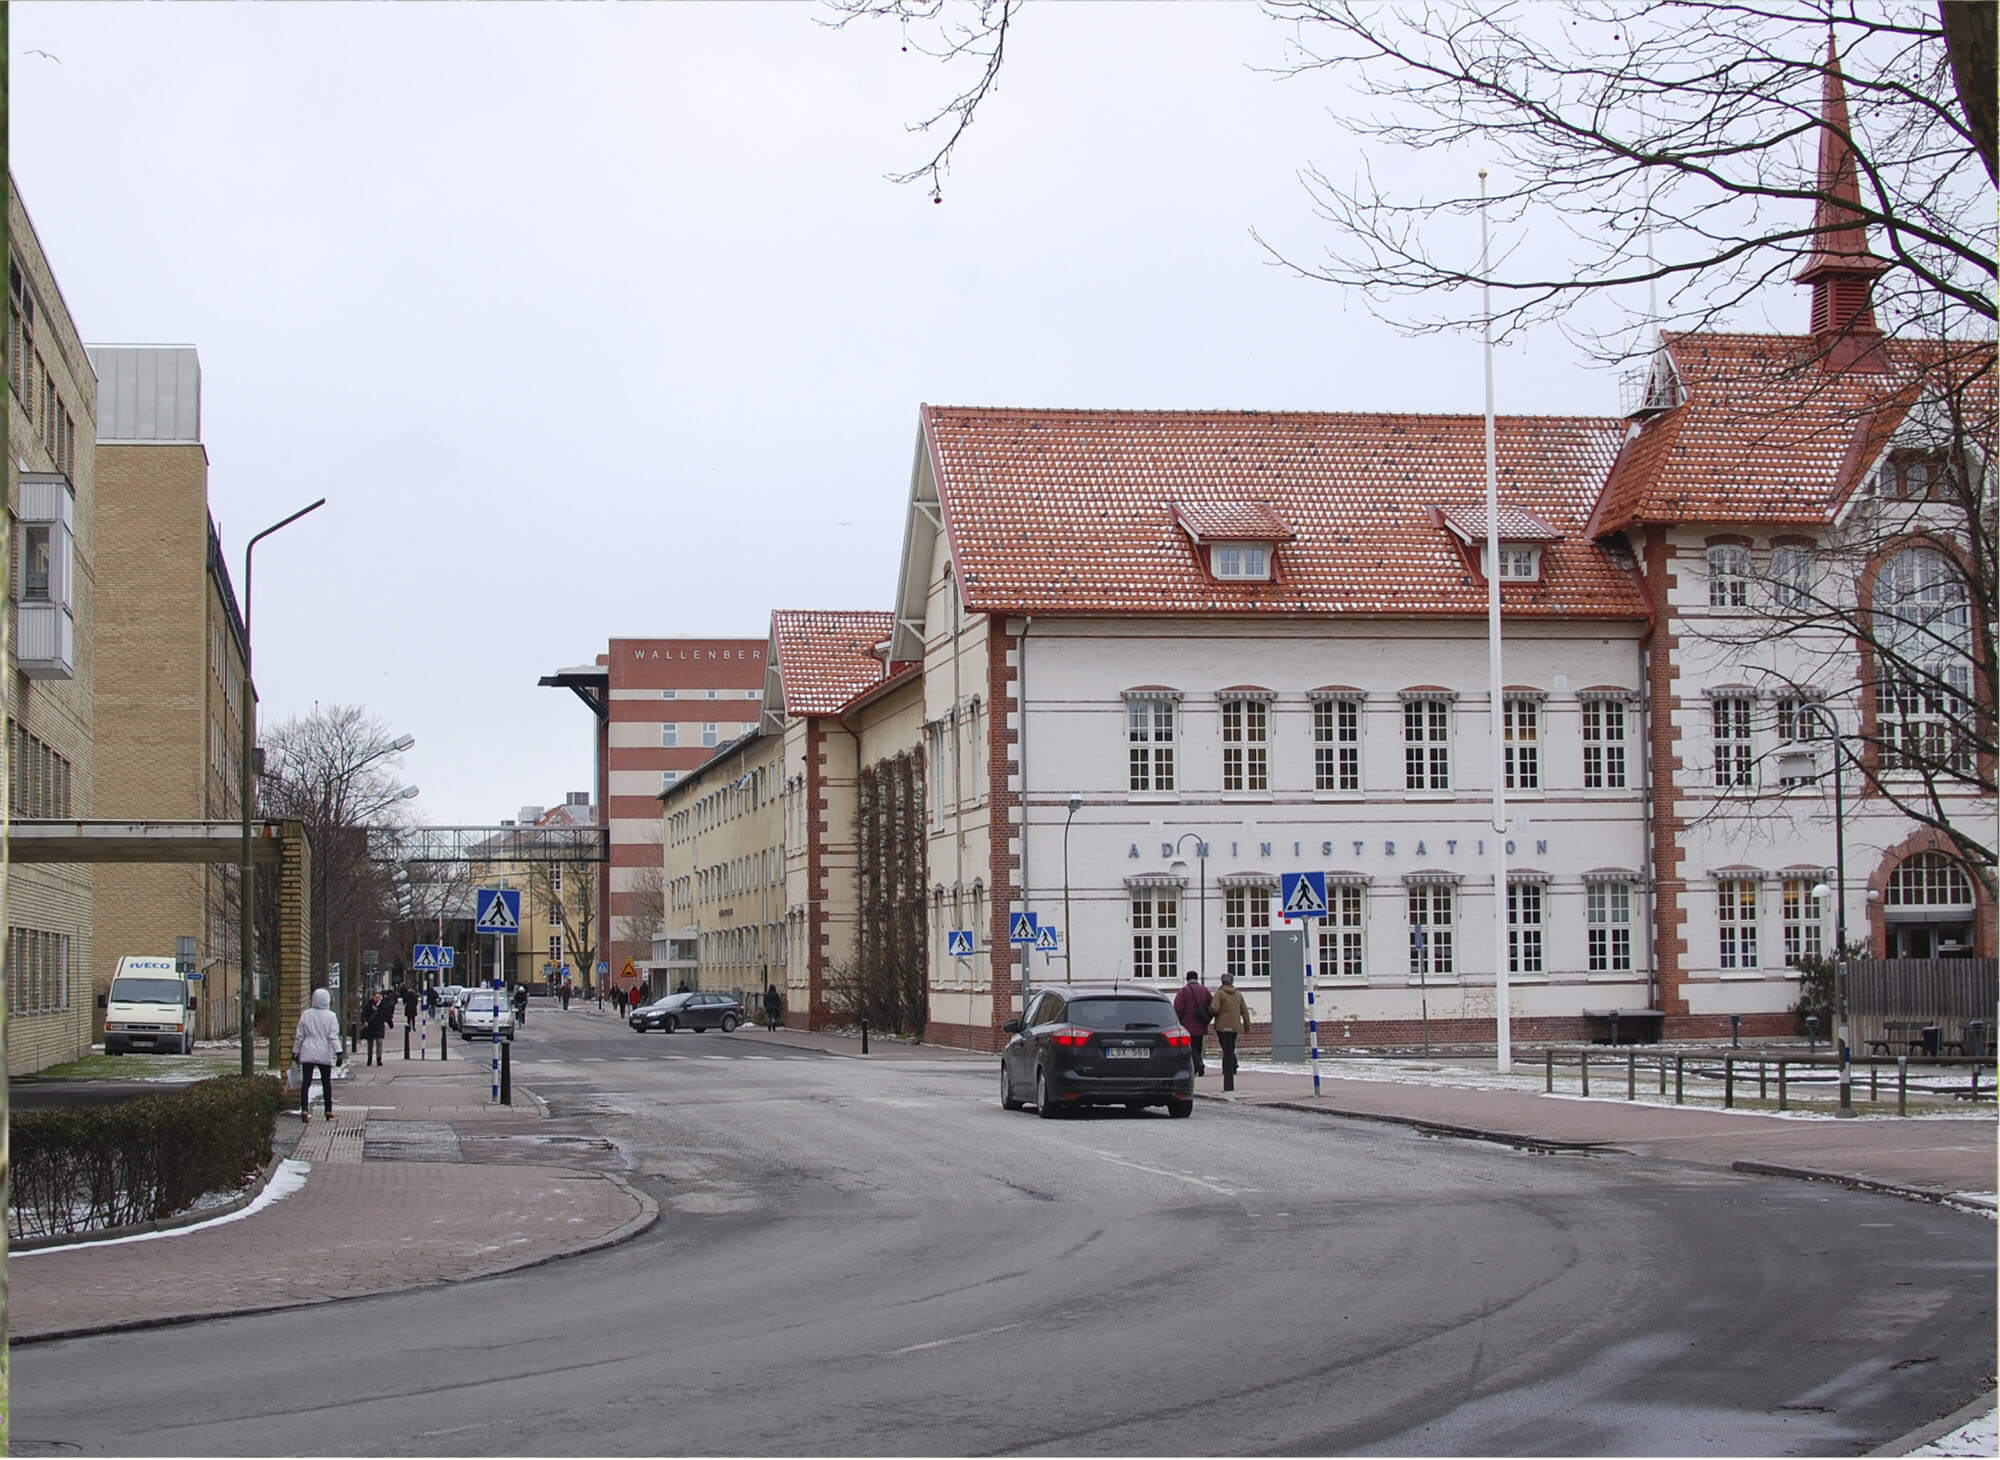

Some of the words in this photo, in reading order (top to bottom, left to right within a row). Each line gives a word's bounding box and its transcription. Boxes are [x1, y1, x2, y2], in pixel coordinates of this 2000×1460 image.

[634, 649, 761, 660] WALLENBER
[1127, 839, 1548, 859] ADMINISTRATION
[129, 961, 171, 970] IVECO
